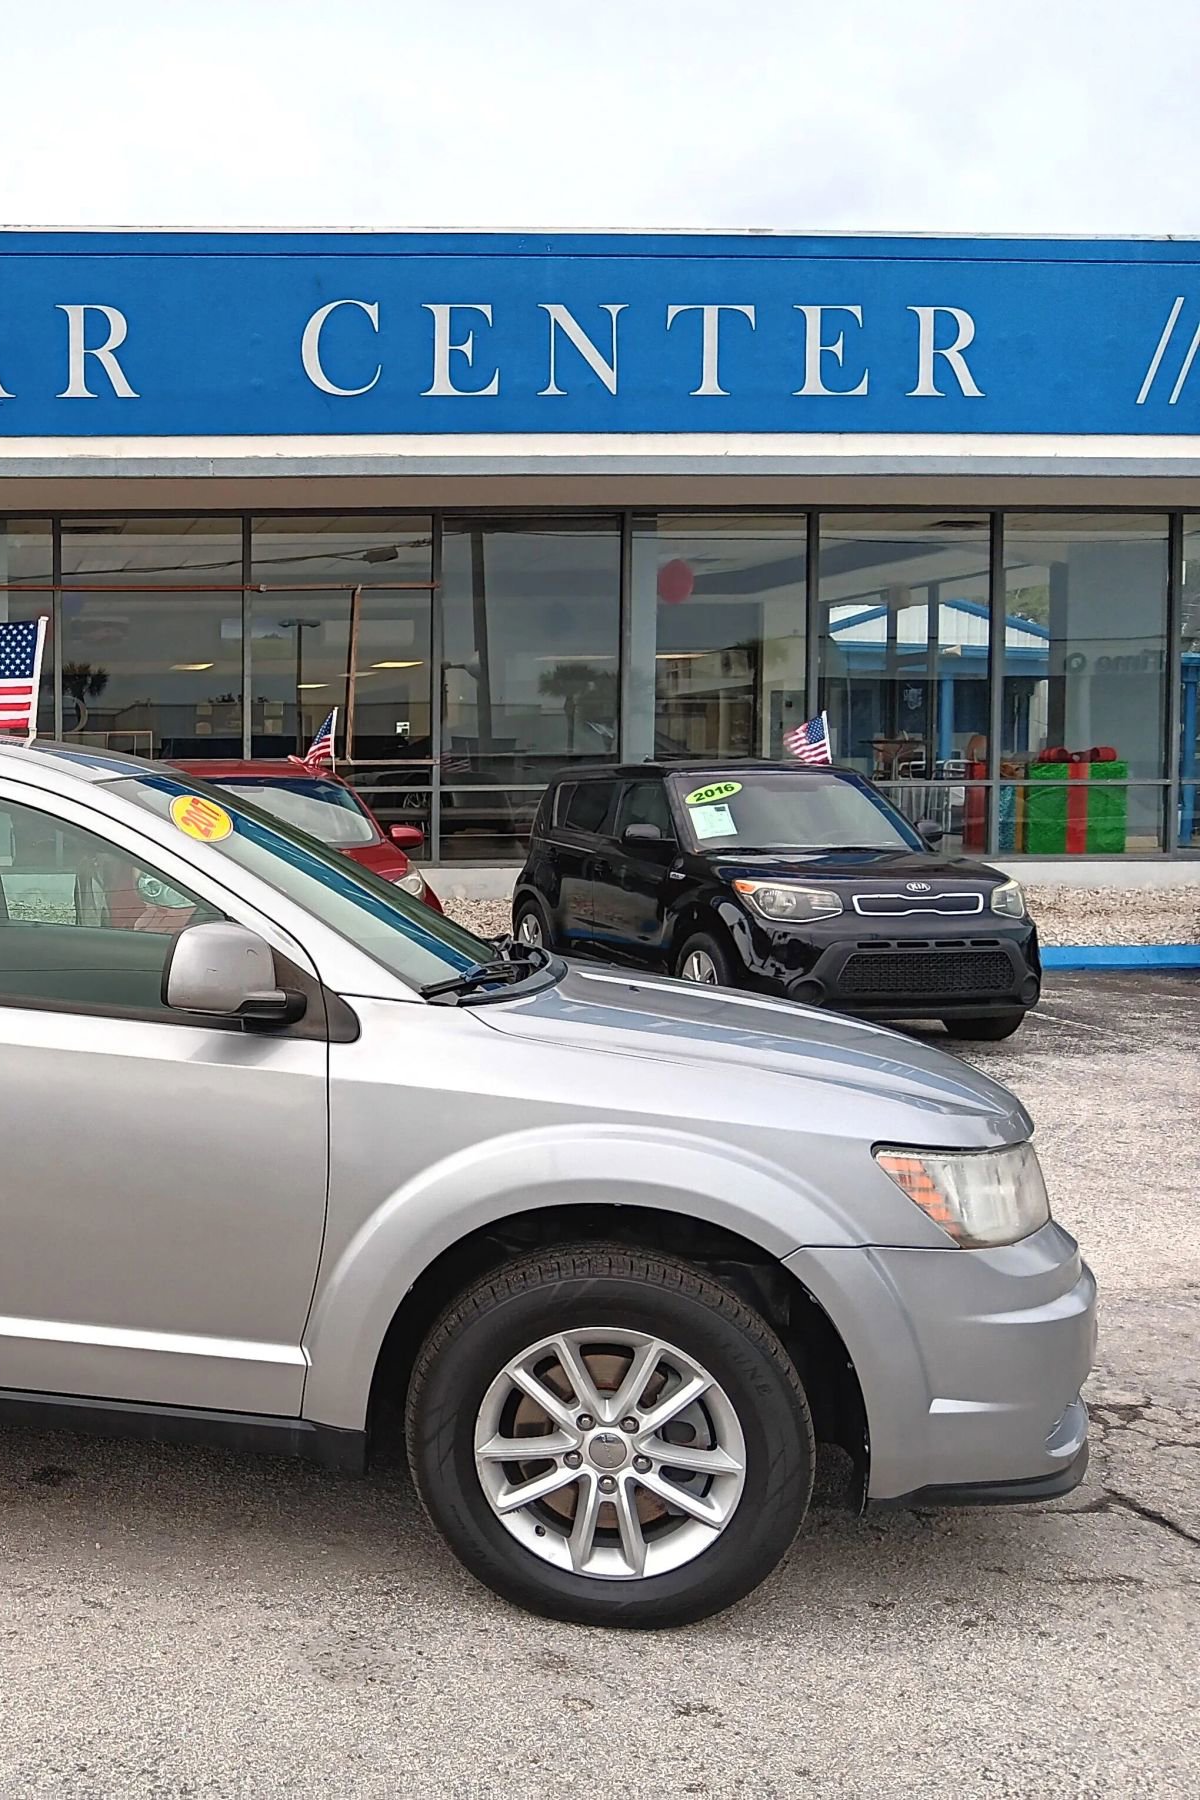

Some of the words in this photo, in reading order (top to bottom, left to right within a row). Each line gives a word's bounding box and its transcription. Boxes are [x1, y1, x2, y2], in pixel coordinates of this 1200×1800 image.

[302, 300, 986, 397] CENTER
[693, 783, 735, 802] 2016
[181, 797, 221, 837] 2017
[907, 881, 930, 892] KIA
